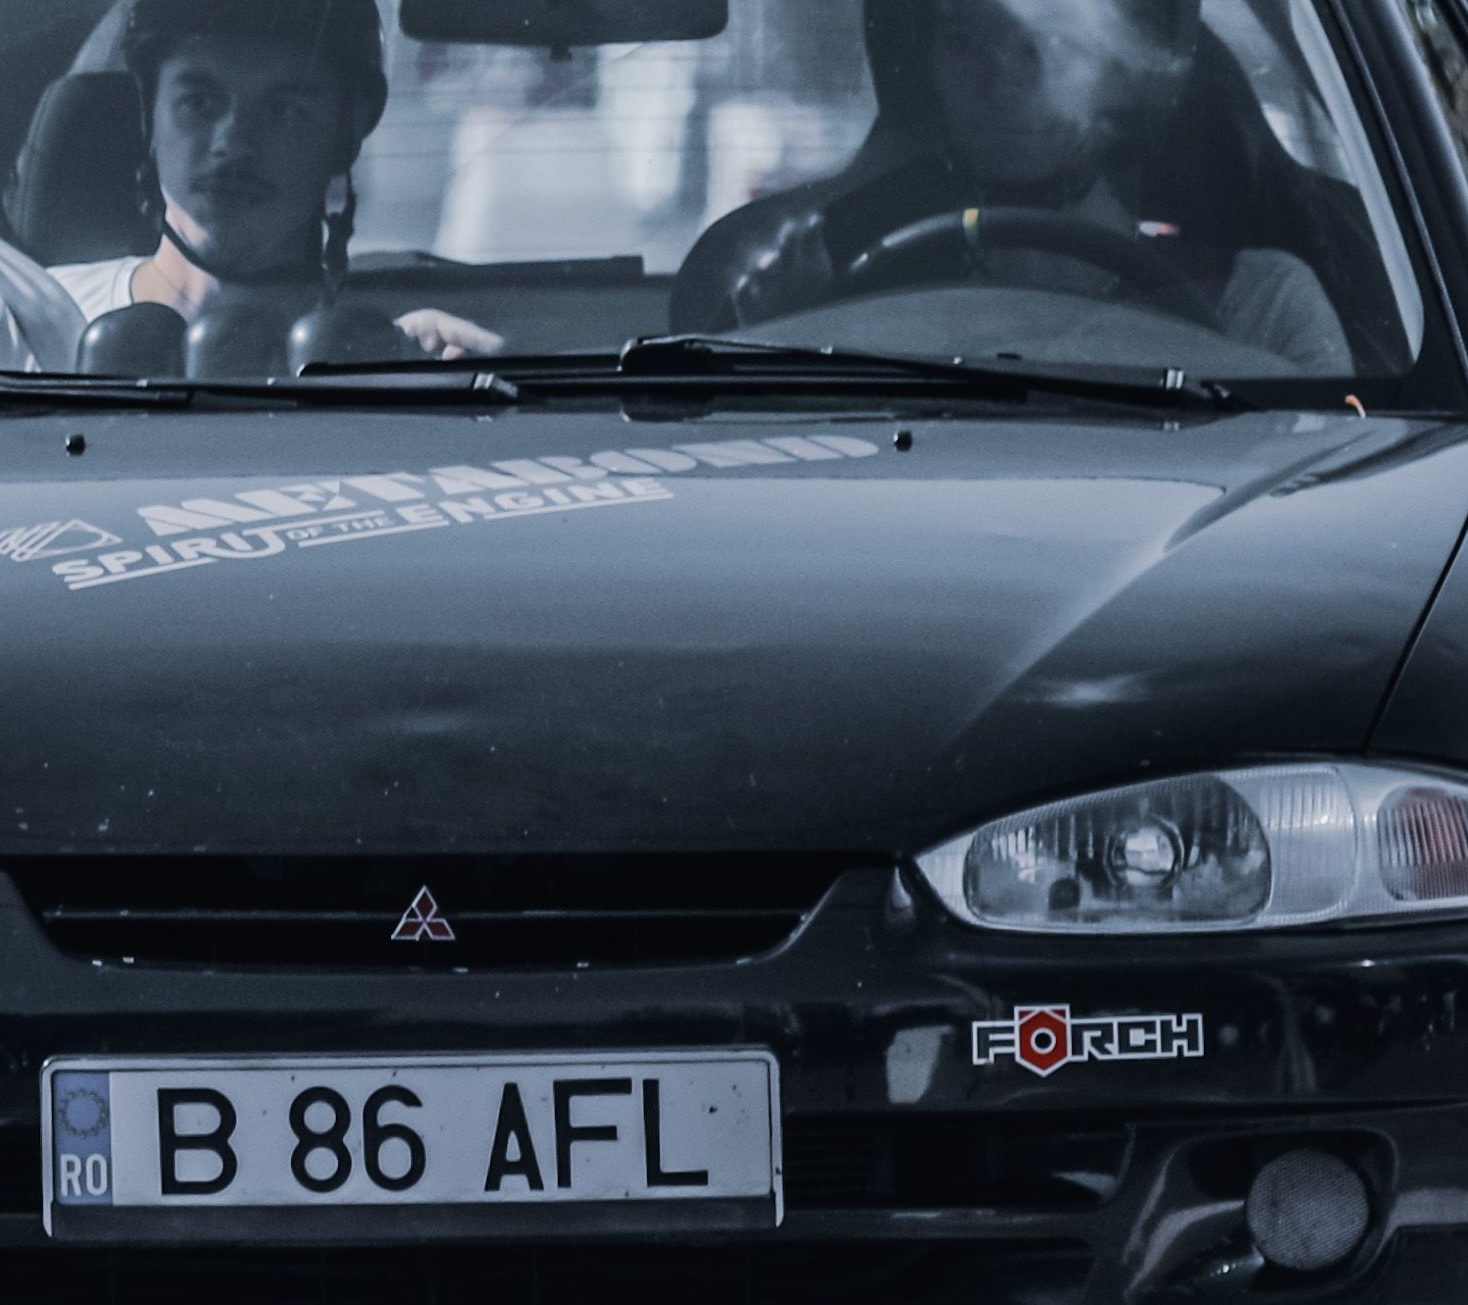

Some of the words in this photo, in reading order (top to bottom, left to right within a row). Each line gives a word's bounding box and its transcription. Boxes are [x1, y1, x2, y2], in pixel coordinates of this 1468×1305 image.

[136, 435, 880, 537] METABOND
[285, 522, 324, 543] OF
[336, 511, 396, 535] THE
[395, 477, 669, 526] ENGINE
[59, 1153, 109, 1197] RO
[157, 1087, 238, 1196] B
[288, 1084, 427, 1193] 86
[484, 1077, 710, 1192] AFL
